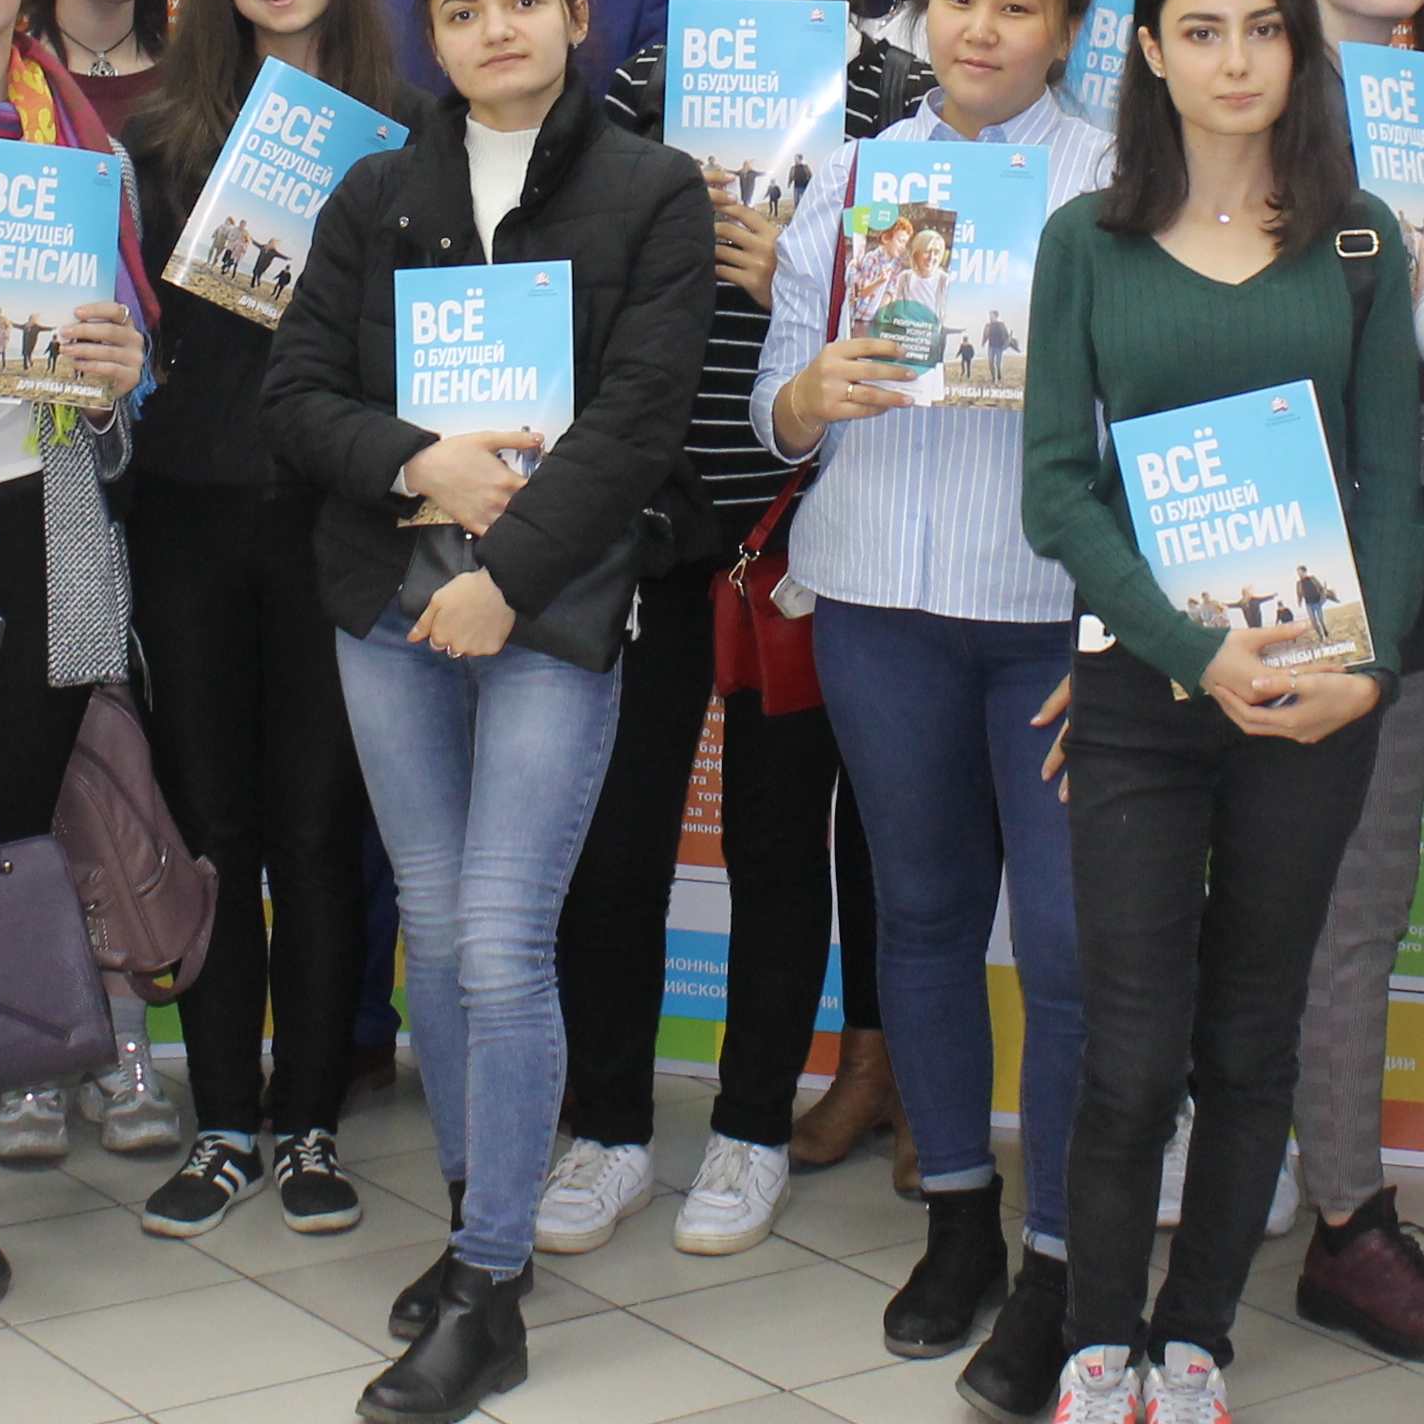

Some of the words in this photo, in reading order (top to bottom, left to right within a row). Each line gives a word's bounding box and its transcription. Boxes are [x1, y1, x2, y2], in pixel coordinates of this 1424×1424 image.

[683, 19, 757, 70] ВСЁ
[1090, 7, 1134, 52] ВС
[683, 74, 694, 90] О
[698, 70, 779, 94] БУДУЩЕЙ
[1360, 70, 1419, 123] ВСЁ
[255, 92, 335, 157] ВСЁ
[681, 96, 813, 129] ПЕНСИИ
[1367, 122, 1377, 140] О
[246, 134, 259, 151] О
[260, 142, 334, 187] БУДУЩЕЙ
[230, 153, 329, 220] ПЕНСИ
[872, 163, 953, 209] ВСЁ
[412, 288, 485, 344] ВСЁ
[414, 350, 424, 367] О
[428, 340, 505, 367] БУДУЩЕЙ
[17, 379, 35, 391] ДЛЯ
[72, 385, 104, 398] ЖИЗНИ
[412, 366, 537, 405] ПЕНСИИ
[991, 388, 1024, 400] ЖИЗНИ
[1137, 427, 1227, 501] ВСЁ
[1150, 505, 1164, 525] О
[1166, 479, 1260, 521] БУДУЩЕЙ
[1156, 501, 1307, 567] ПЕНСИИ
[1321, 641, 1357, 656] ЖИЗНИ
